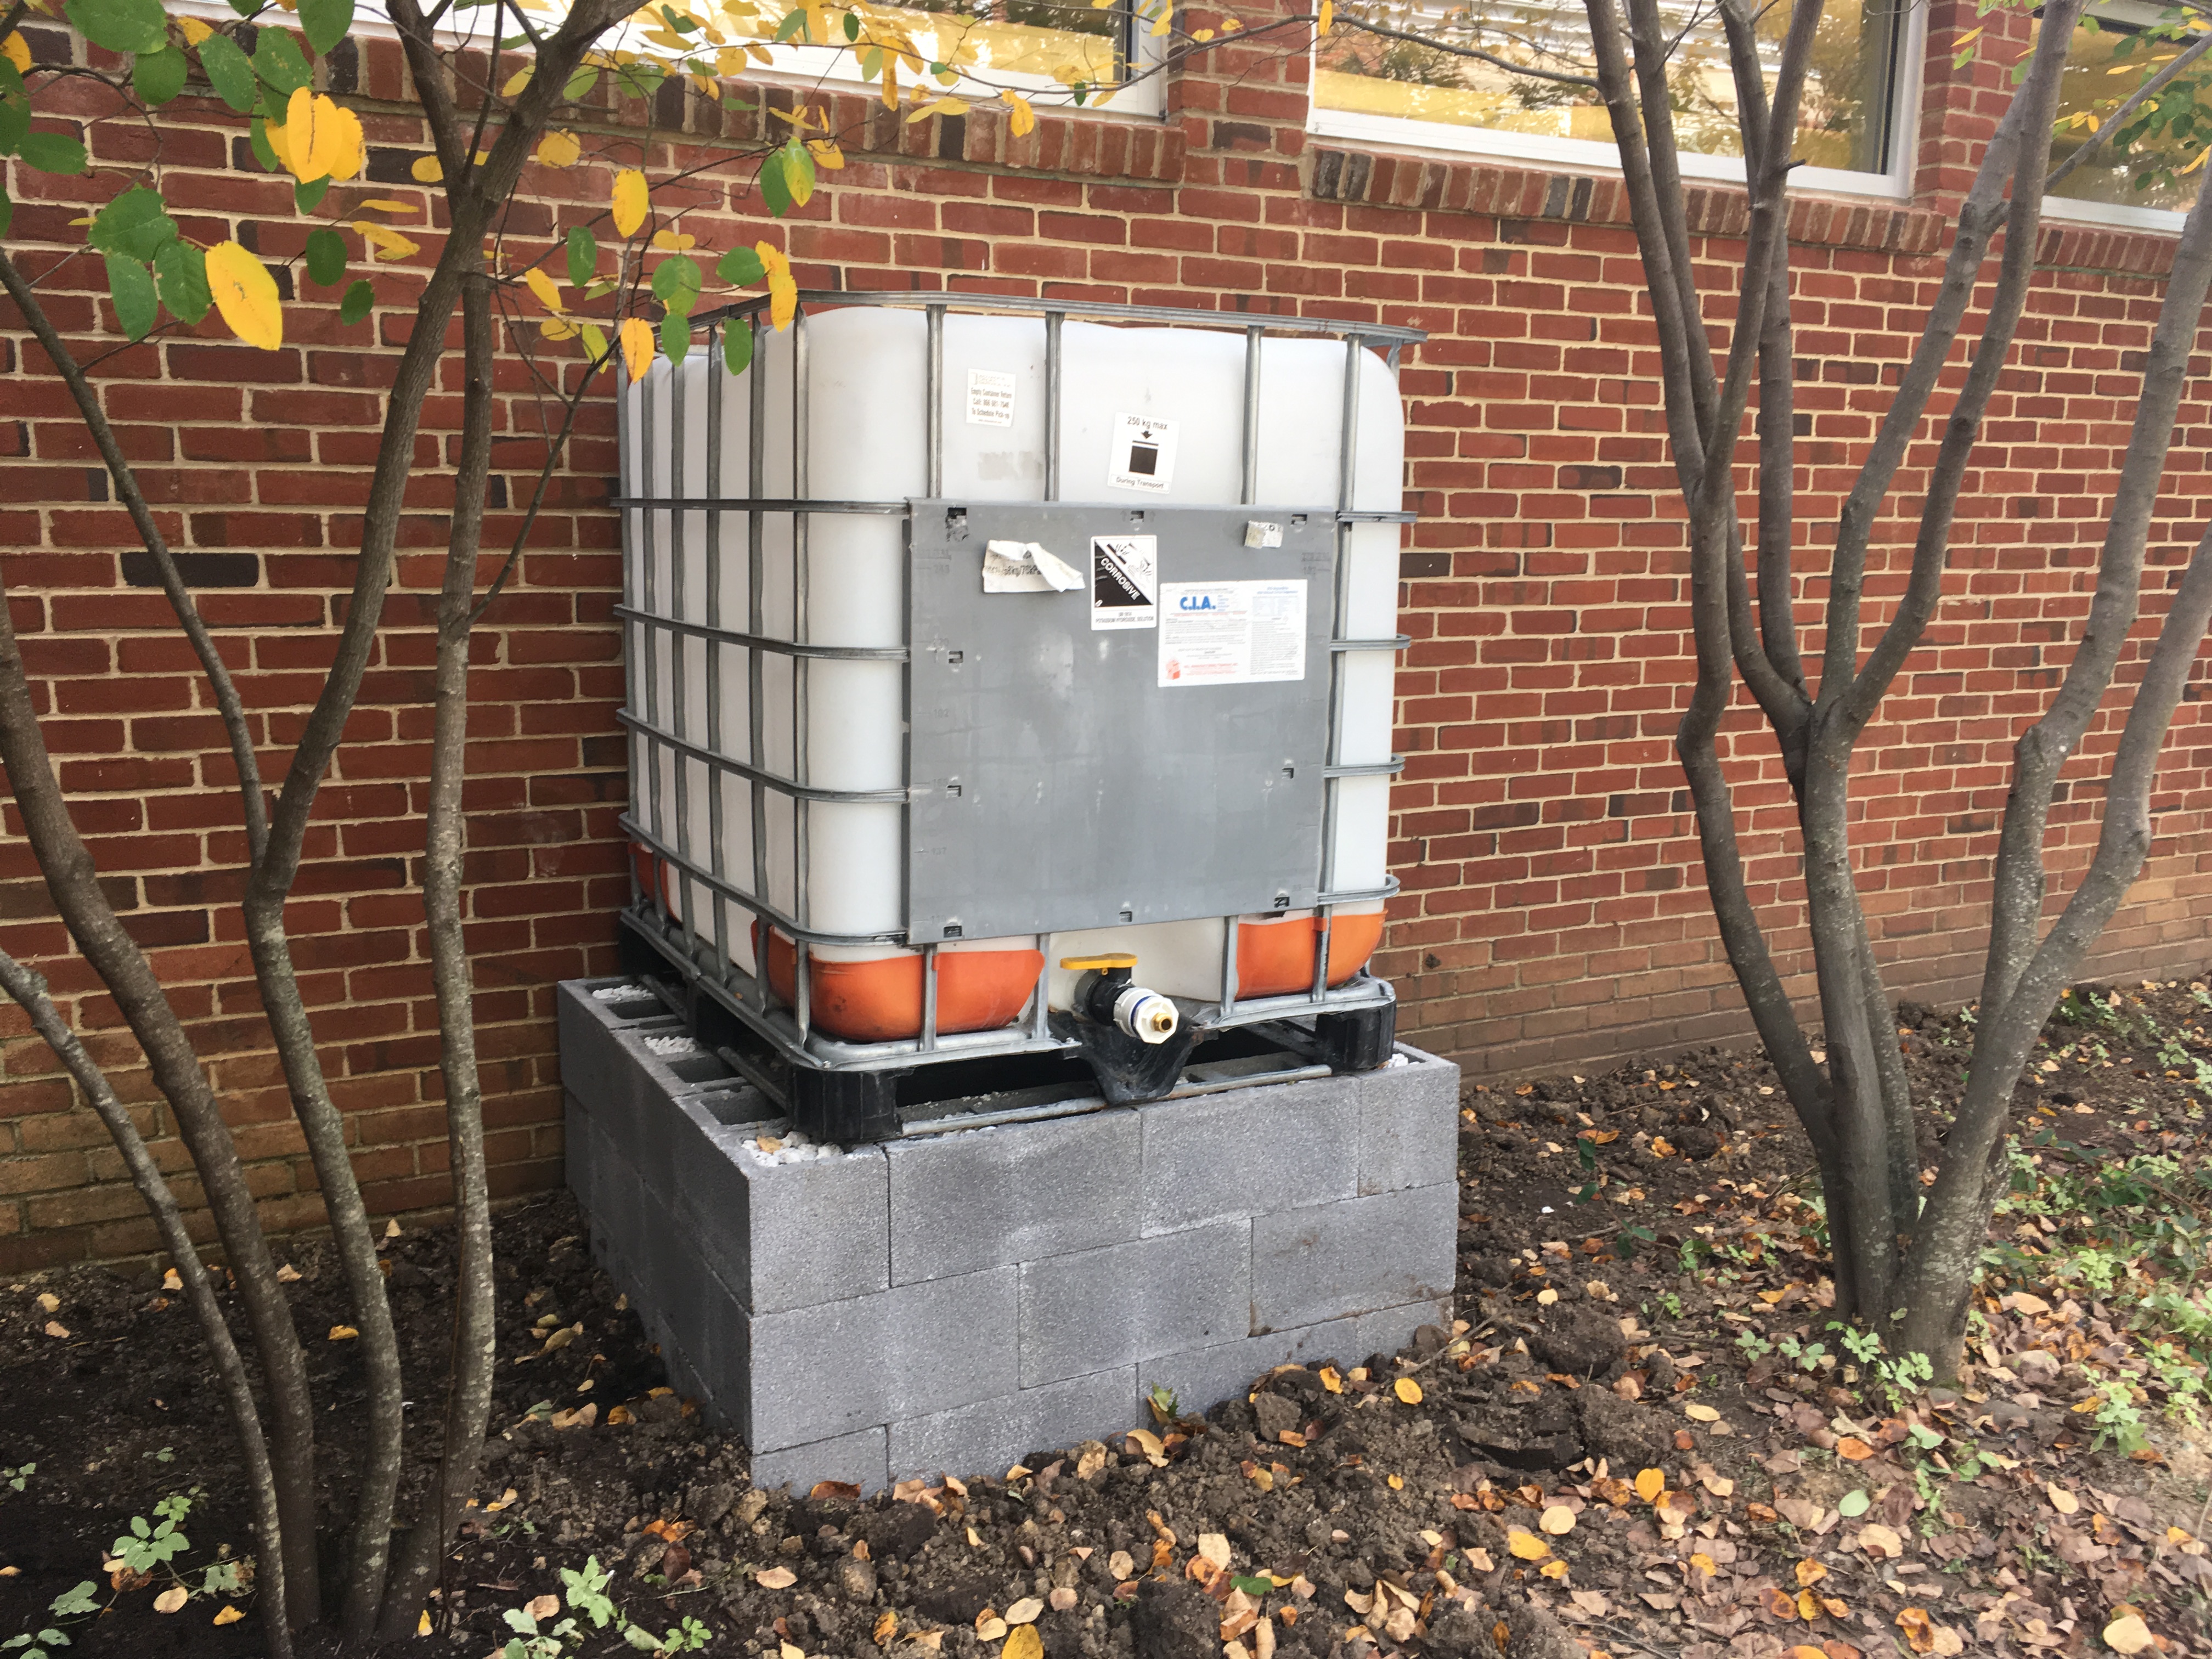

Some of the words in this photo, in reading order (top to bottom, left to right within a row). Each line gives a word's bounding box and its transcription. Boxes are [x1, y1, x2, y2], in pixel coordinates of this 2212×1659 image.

[1127, 416, 1141, 426] 250
[1142, 418, 1151, 430] kg
[1153, 421, 1168, 430] max
[1116, 476, 1136, 486] During
[1137, 479, 1164, 488] Transport
[1101, 557, 1141, 600] CORROSIVE
[1180, 595, 1216, 611] C.I.A.
